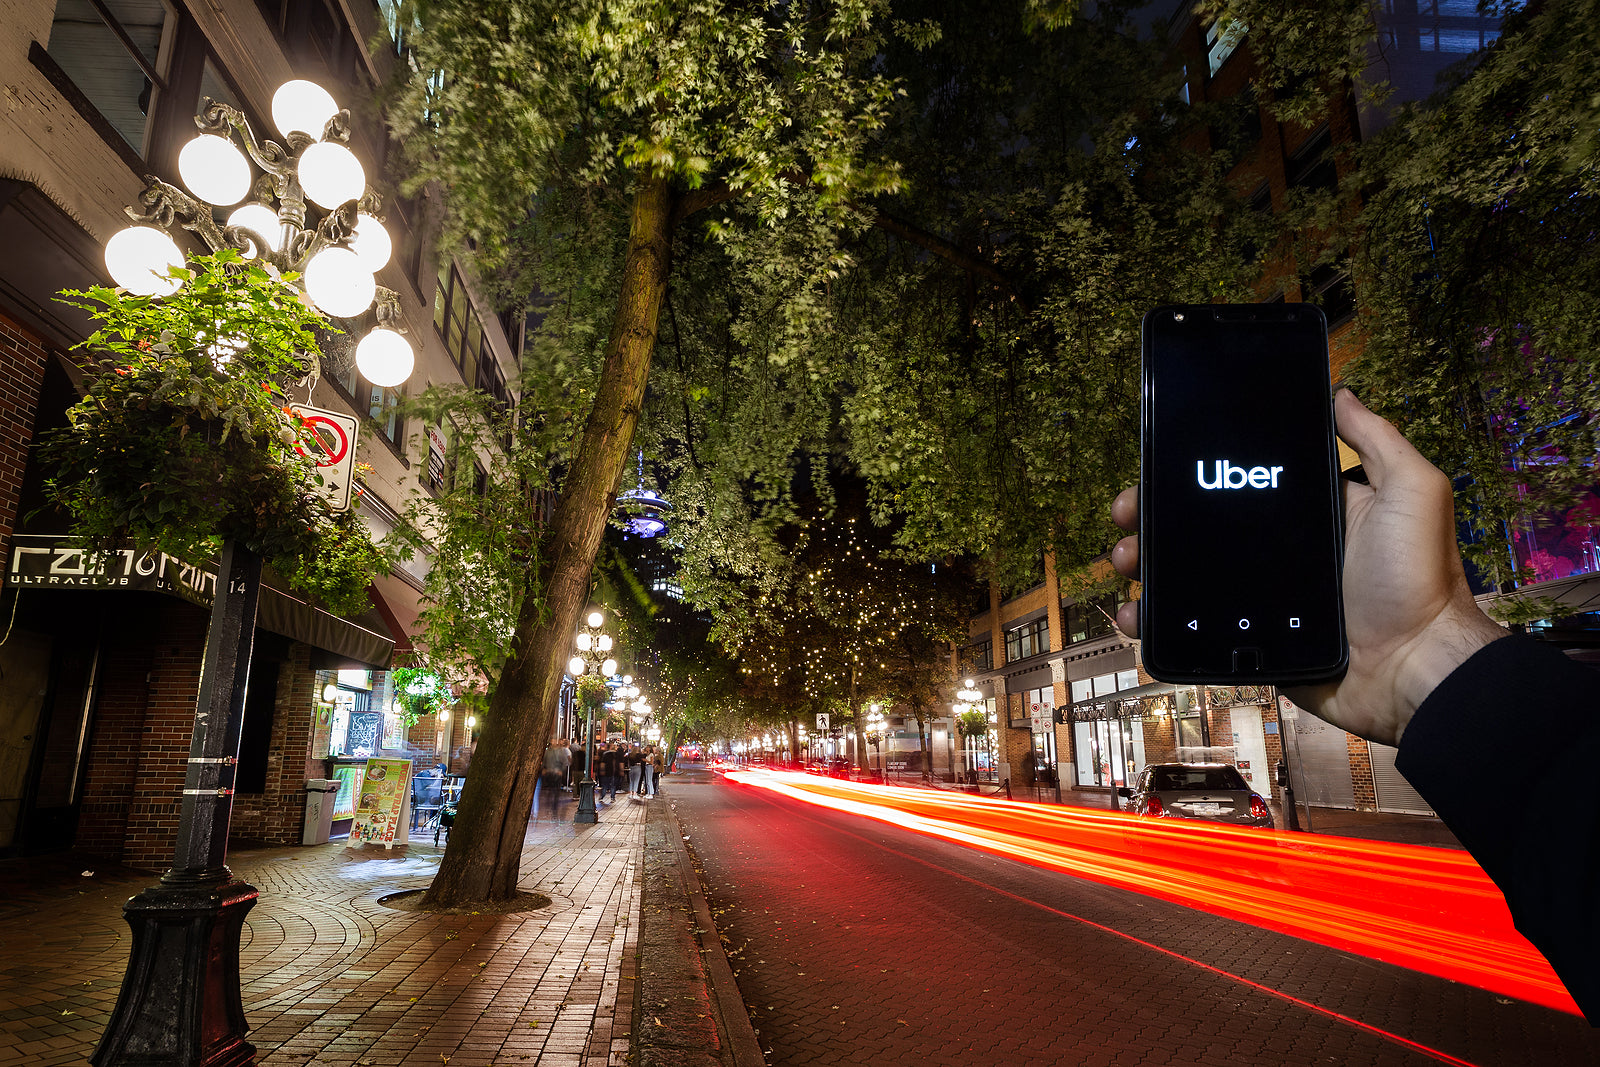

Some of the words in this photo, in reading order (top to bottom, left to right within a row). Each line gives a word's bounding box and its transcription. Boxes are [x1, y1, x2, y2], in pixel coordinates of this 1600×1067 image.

[1196, 459, 1284, 491] Uber
[229, 580, 247, 595] 14
[396, 763, 410, 791] WORLD
[391, 792, 403, 815] WRAP
[384, 816, 398, 842] PLACE
